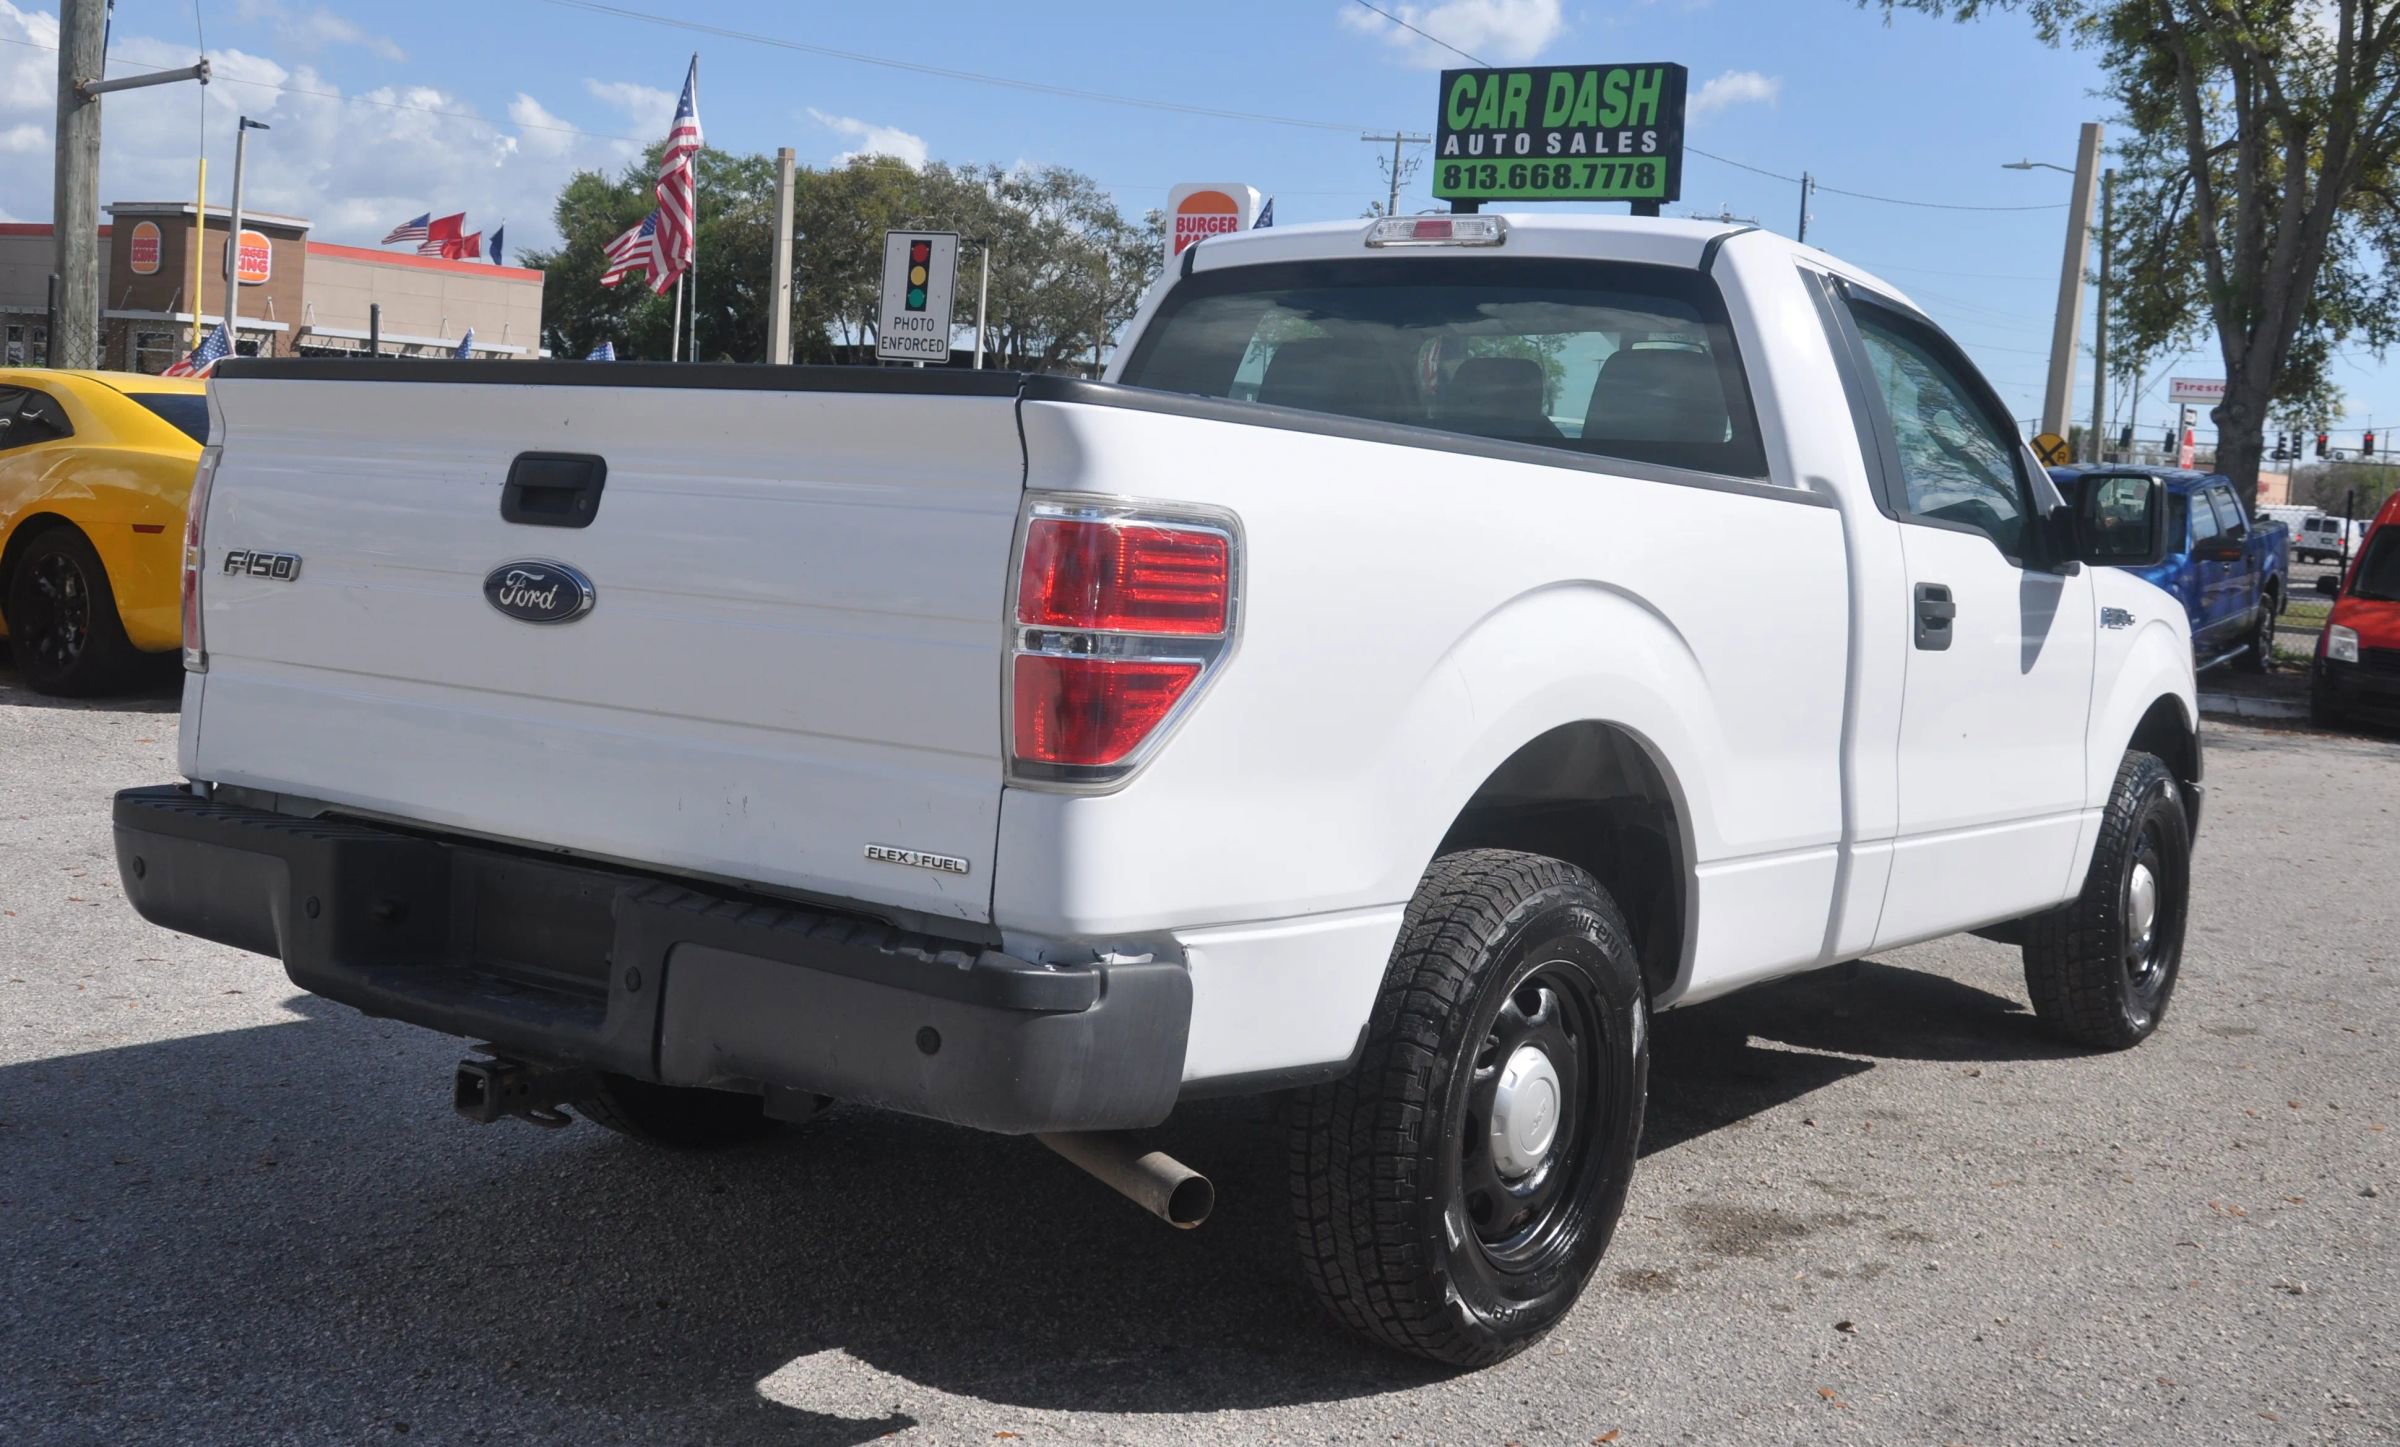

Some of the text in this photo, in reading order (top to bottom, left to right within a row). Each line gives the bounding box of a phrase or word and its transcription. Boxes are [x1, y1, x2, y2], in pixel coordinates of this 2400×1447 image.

[1448, 68, 1664, 131] CAR DASH
[1444, 130, 1658, 155] AUTO SALES
[1443, 162, 1656, 190] 813.668.7778
[1175, 216, 1238, 233] BURGER
[238, 257, 269, 273] ING
[893, 316, 935, 332] PHOTO
[881, 336, 945, 353] ENFORCED
[2175, 381, 2227, 393] Firesto
[222, 549, 300, 581] F-150
[499, 569, 559, 611] Ford
[867, 846, 963, 872] FLEX FUEL
